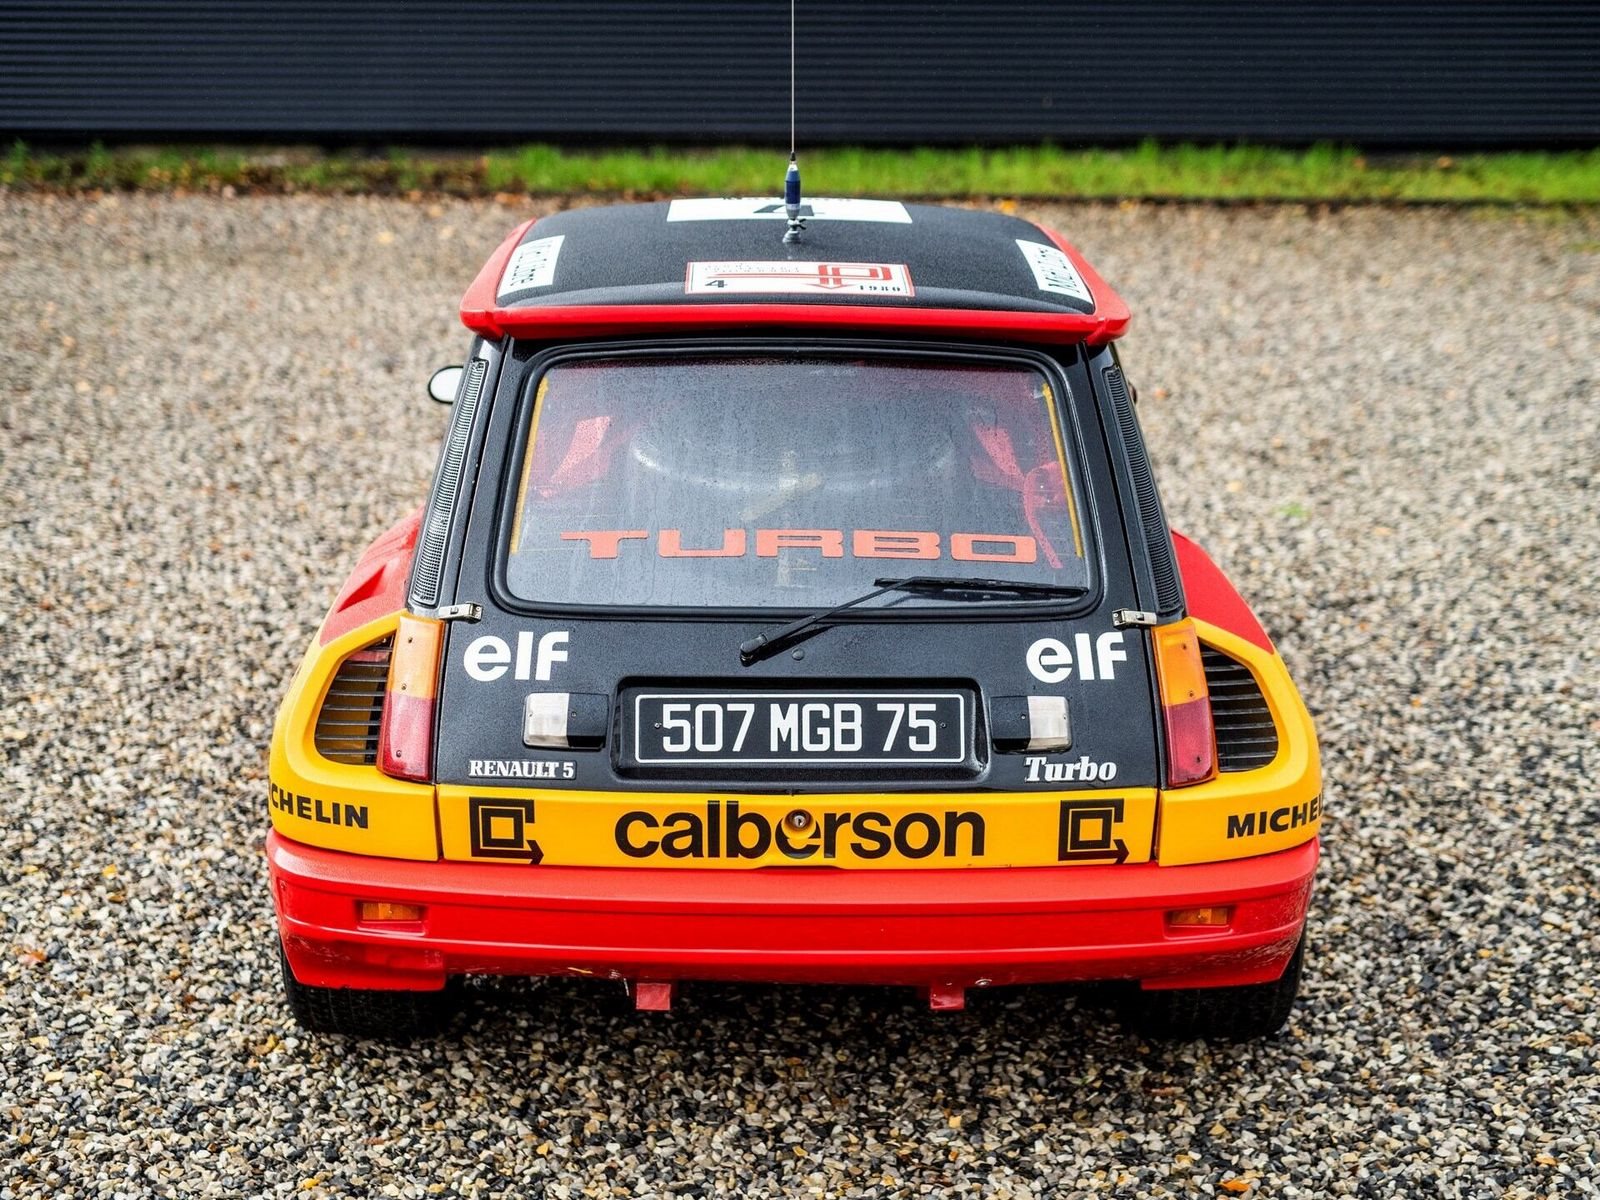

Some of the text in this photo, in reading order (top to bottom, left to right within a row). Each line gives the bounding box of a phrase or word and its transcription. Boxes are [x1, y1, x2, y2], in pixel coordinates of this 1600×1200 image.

[753, 204, 824, 217] 4
[704, 279, 728, 289] 4
[560, 528, 1038, 563] TURBO
[463, 630, 569, 683] elf
[1026, 631, 1127, 683] elf
[662, 703, 937, 753] 507 MGB 75
[468, 759, 575, 779] RENAULT 5
[1024, 755, 1117, 783] Turbo
[614, 800, 985, 859] calberson
